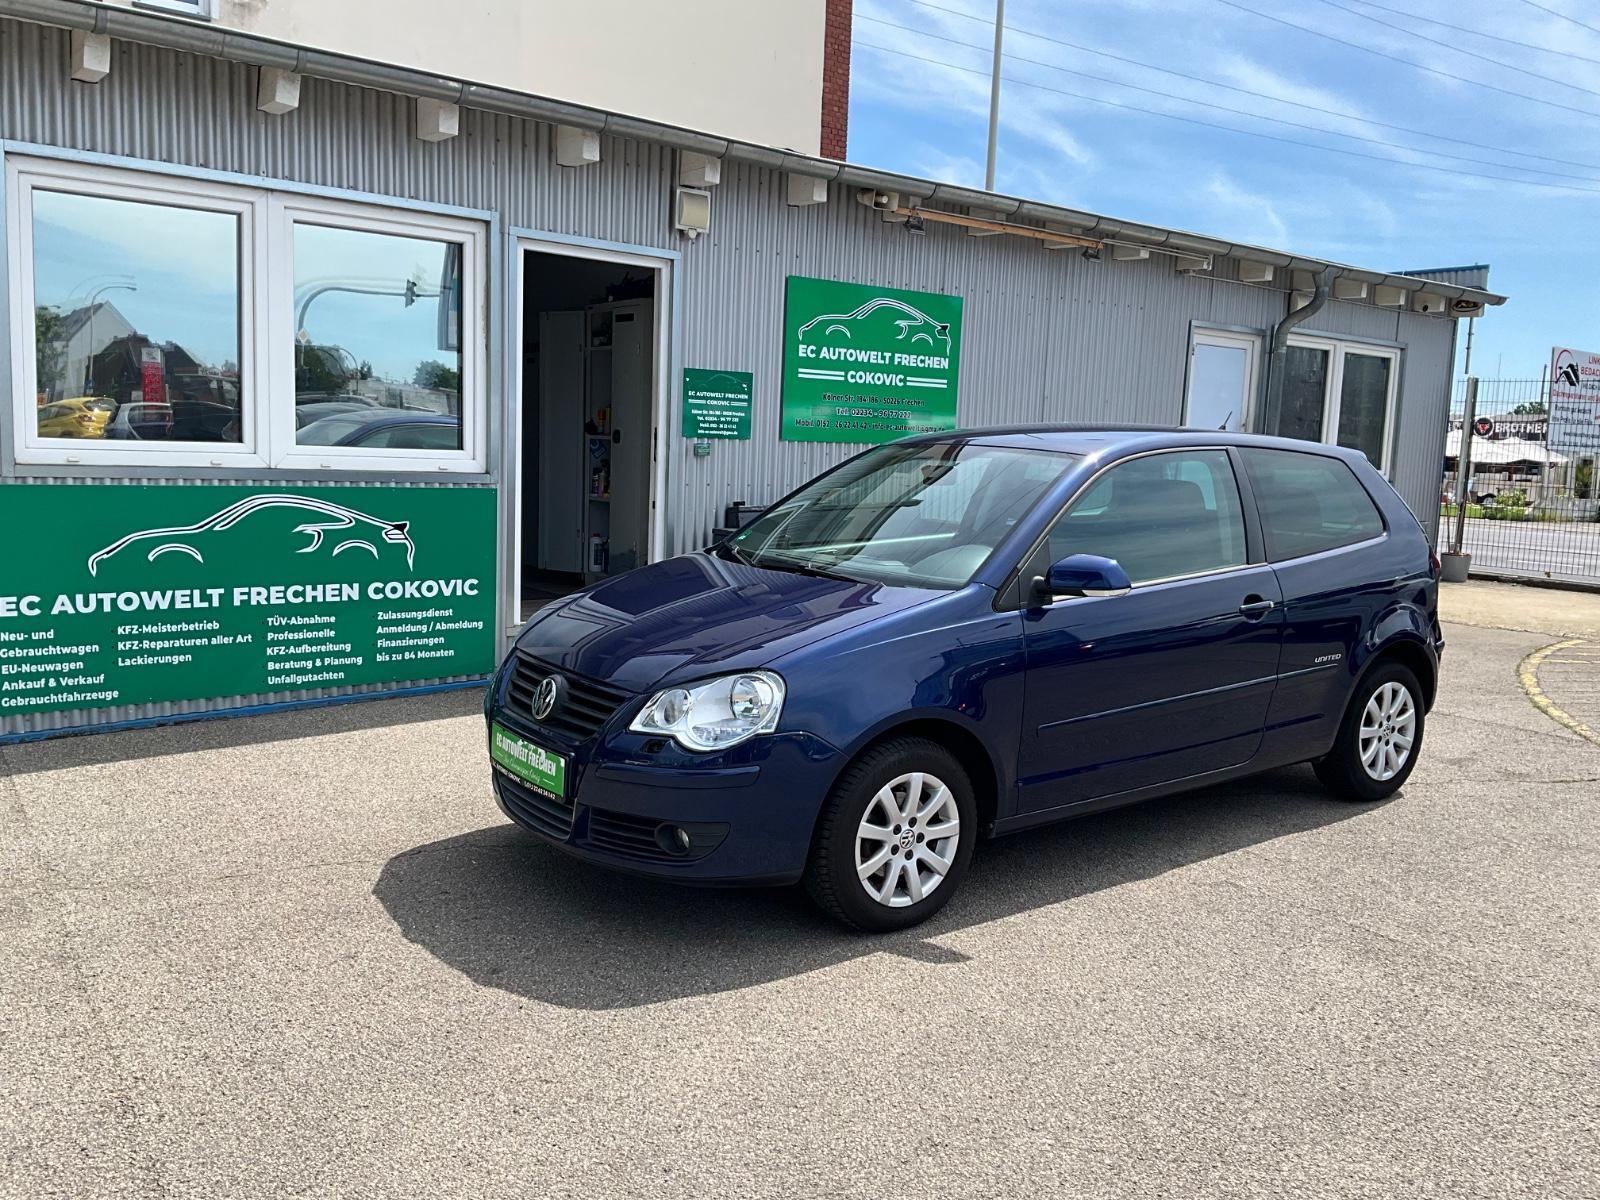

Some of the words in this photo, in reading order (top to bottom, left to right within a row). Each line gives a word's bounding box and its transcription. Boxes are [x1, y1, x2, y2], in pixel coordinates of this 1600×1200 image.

[798, 344, 817, 358] EC
[819, 346, 892, 365] AUTOWELT
[894, 353, 949, 369] FRECHEN
[847, 370, 904, 386] COKOVIC
[0, 595, 41, 617] EC
[50, 588, 225, 614] AUTOWELT
[233, 583, 359, 606] FRECHEN
[367, 579, 479, 600] COKOVIC
[267, 615, 336, 626] TÜV-Abnahme
[377, 608, 453, 621] Zulassungsdienst
[117, 620, 220, 635] KFZ-Meisterbetrieb
[376, 623, 428, 635] Anmeldung
[435, 620, 484, 631] Abmeldung
[0, 631, 29, 642] Neu-
[32, 629, 54, 640] und
[267, 629, 335, 641] Professionelle
[377, 636, 445, 648] Finanzierungen
[117, 637, 209, 651] KFZ-Reparaturen
[211, 634, 234, 645] aller
[236, 634, 252, 643] Art
[266, 642, 352, 656] KFZ-Aufbereitung
[0, 643, 99, 658] Gebrauchtwagen
[376, 653, 389, 662] bis
[391, 653, 402, 661] zu
[404, 651, 416, 660] 84
[418, 649, 454, 659] Monaten
[118, 653, 192, 667] Lackierungen
[267, 659, 313, 671] Beratung
[315, 658, 322, 667] &
[324, 655, 363, 667] Planung
[1314, 653, 1342, 663] UNITED
[1, 661, 84, 675] EU-Neuwagen
[2, 679, 45, 691] Ankauf
[48, 677, 57, 688] &
[59, 674, 105, 687] Verkauf
[267, 671, 345, 685] Unfallgutachten
[1, 689, 119, 707] Gebrauchtfahrzeuge
[502, 736, 529, 762] AUTOWELT
[528, 751, 557, 777] FRECHEN
